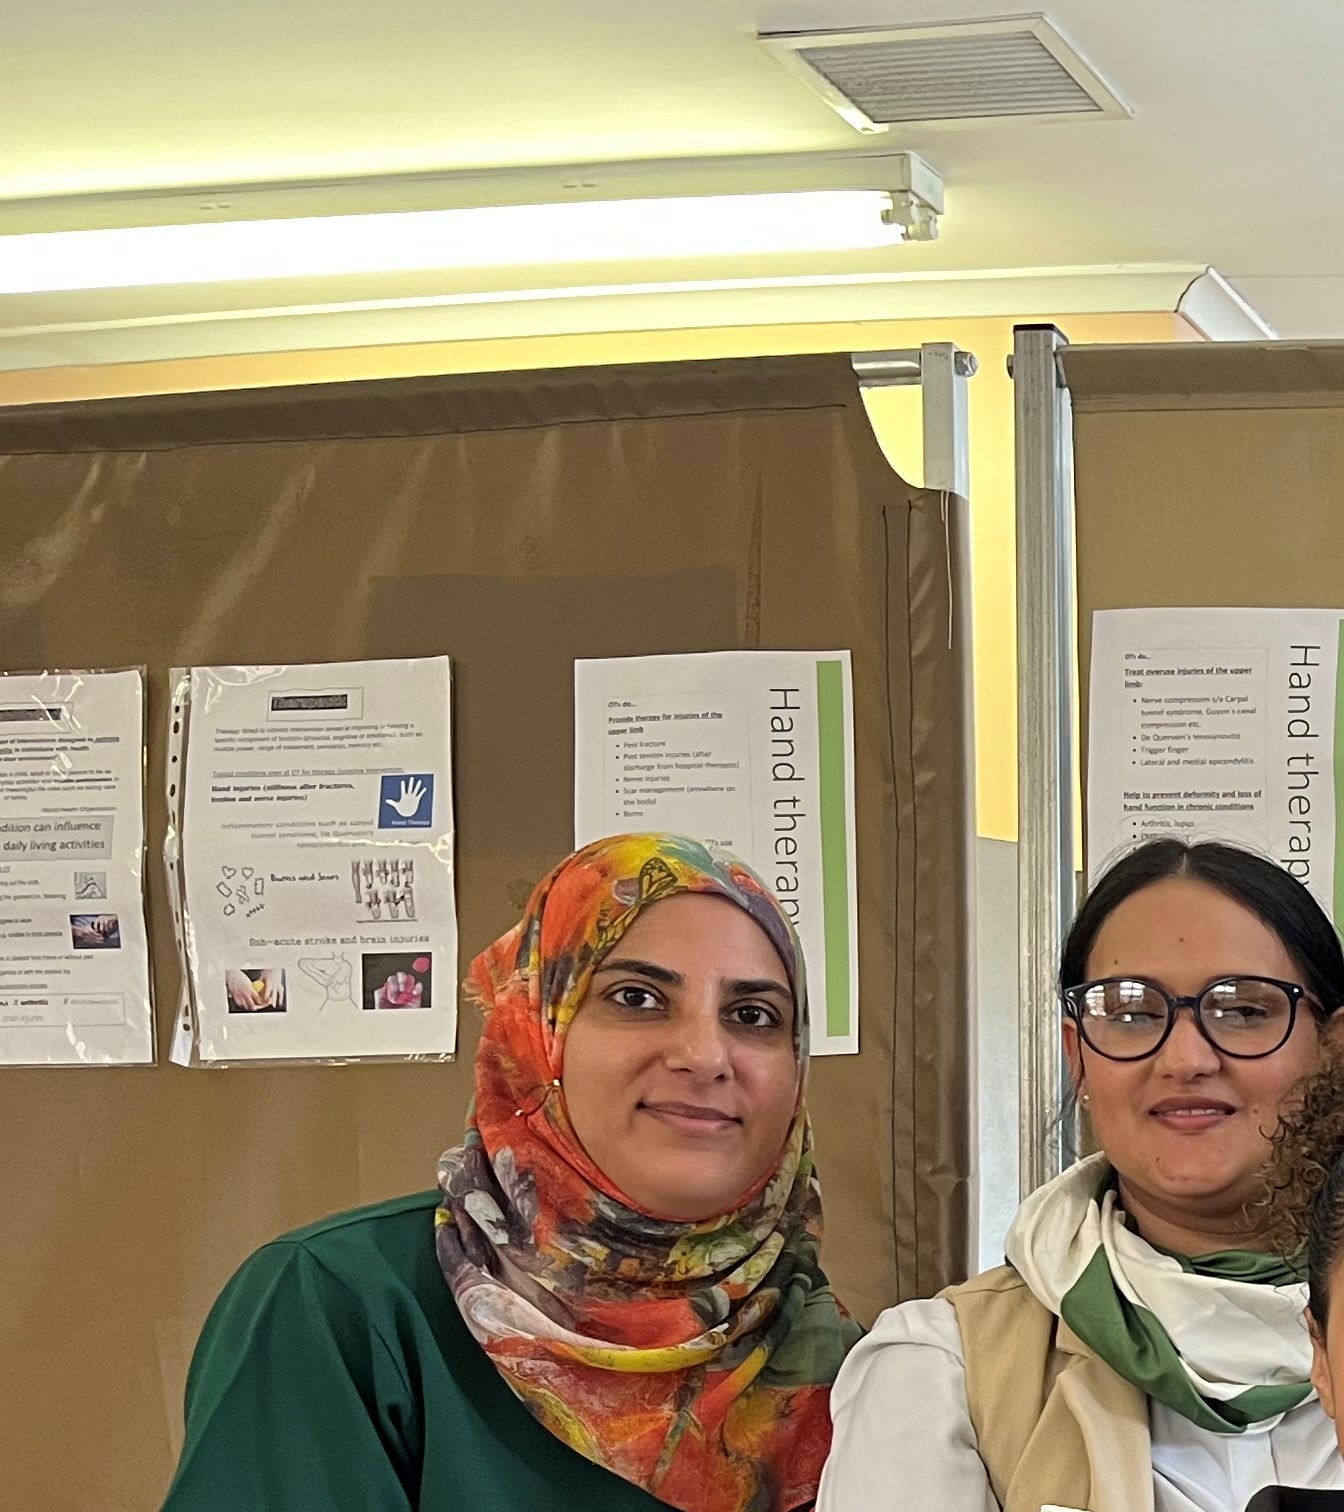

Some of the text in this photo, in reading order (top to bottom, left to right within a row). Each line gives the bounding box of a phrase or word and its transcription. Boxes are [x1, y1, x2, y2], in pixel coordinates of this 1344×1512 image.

[1280, 645, 1321, 885] Hand therap
[769, 688, 807, 925] Hand therap
[0, 822, 31, 831] dition
[54, 822, 101, 830] influence
[4, 840, 105, 851] daily living activities
[250, 938, 301, 946] Sub-acute
[390, 935, 429, 943] injuries
